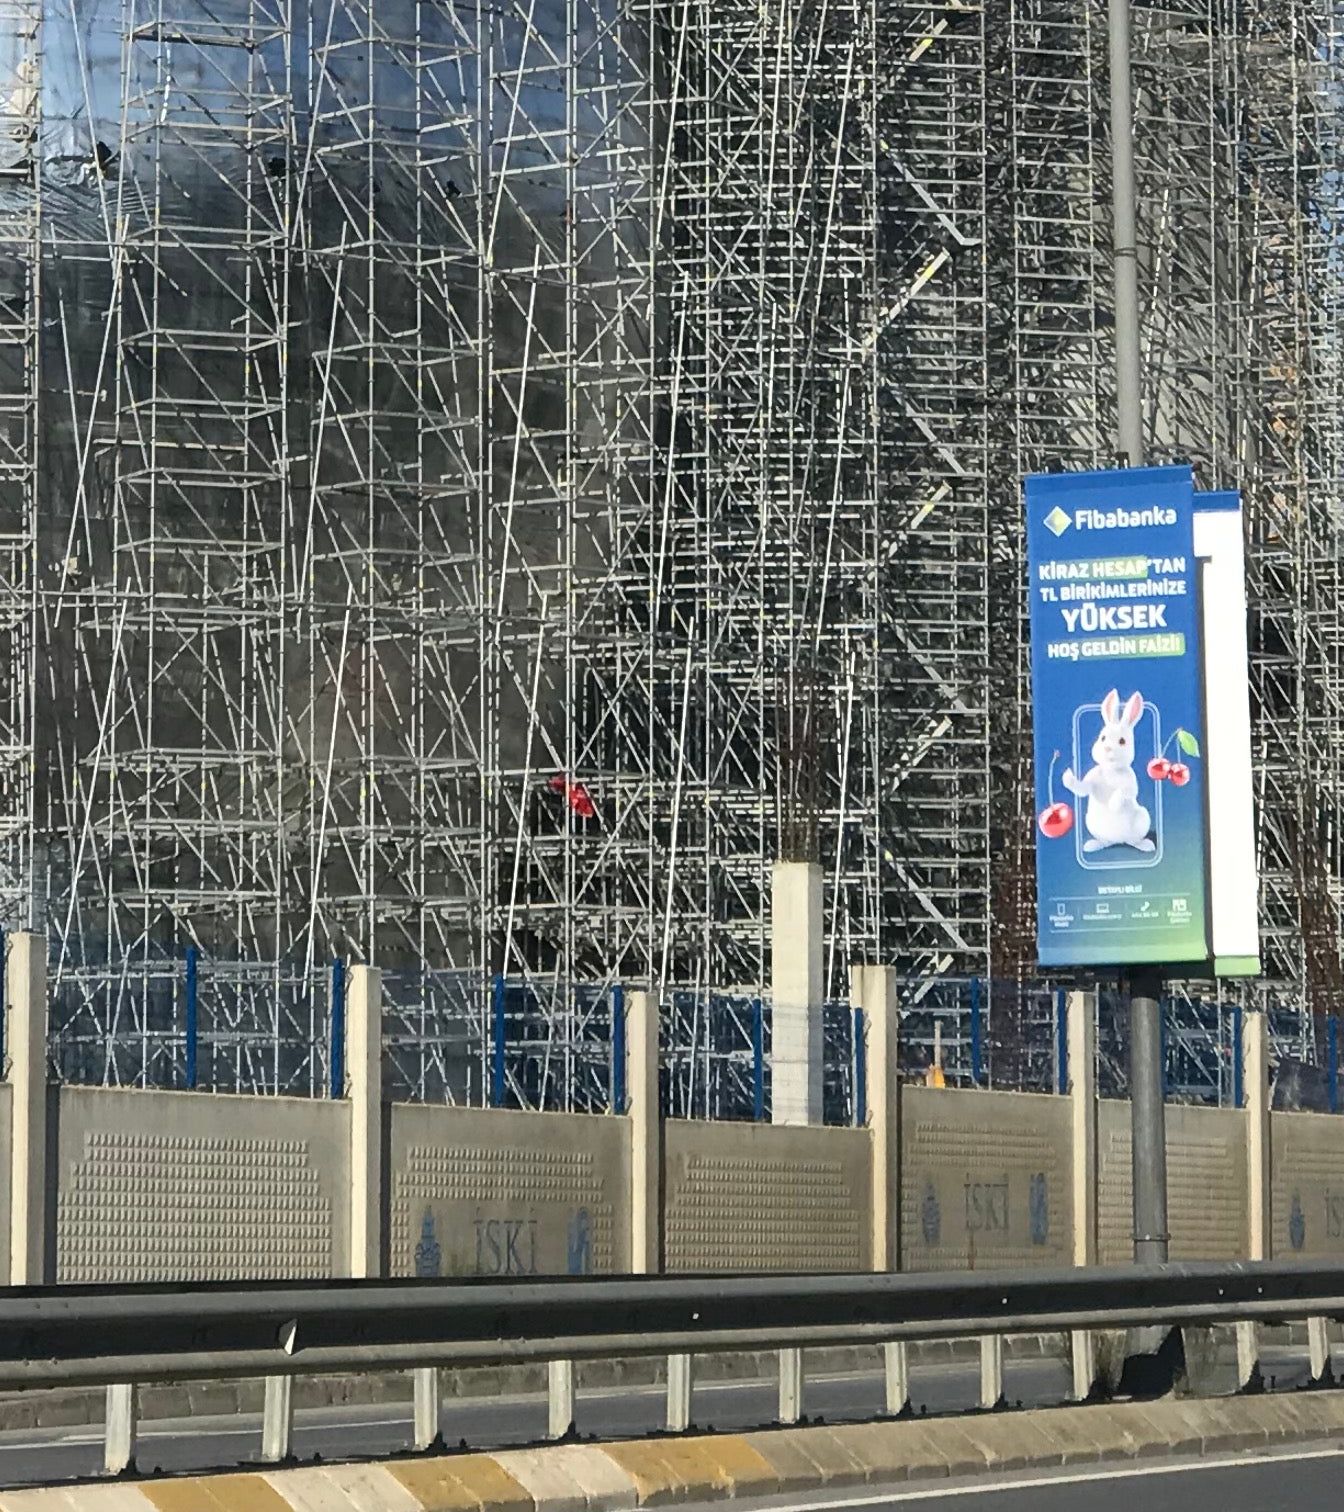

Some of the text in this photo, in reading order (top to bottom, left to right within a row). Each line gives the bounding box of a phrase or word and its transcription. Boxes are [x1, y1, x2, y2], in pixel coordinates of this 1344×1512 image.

[1075, 505, 1177, 530] Fibabanka
[1039, 560, 1090, 580] KİRAZ
[1040, 578, 1187, 602] TL BİRİKİMLERİNİZE
[1061, 602, 1167, 632] YÜKSEK
[1047, 642, 1079, 661] HOŞ
[1081, 636, 1136, 656] GELDİN
[473, 1207, 538, 1275] İSKİ
